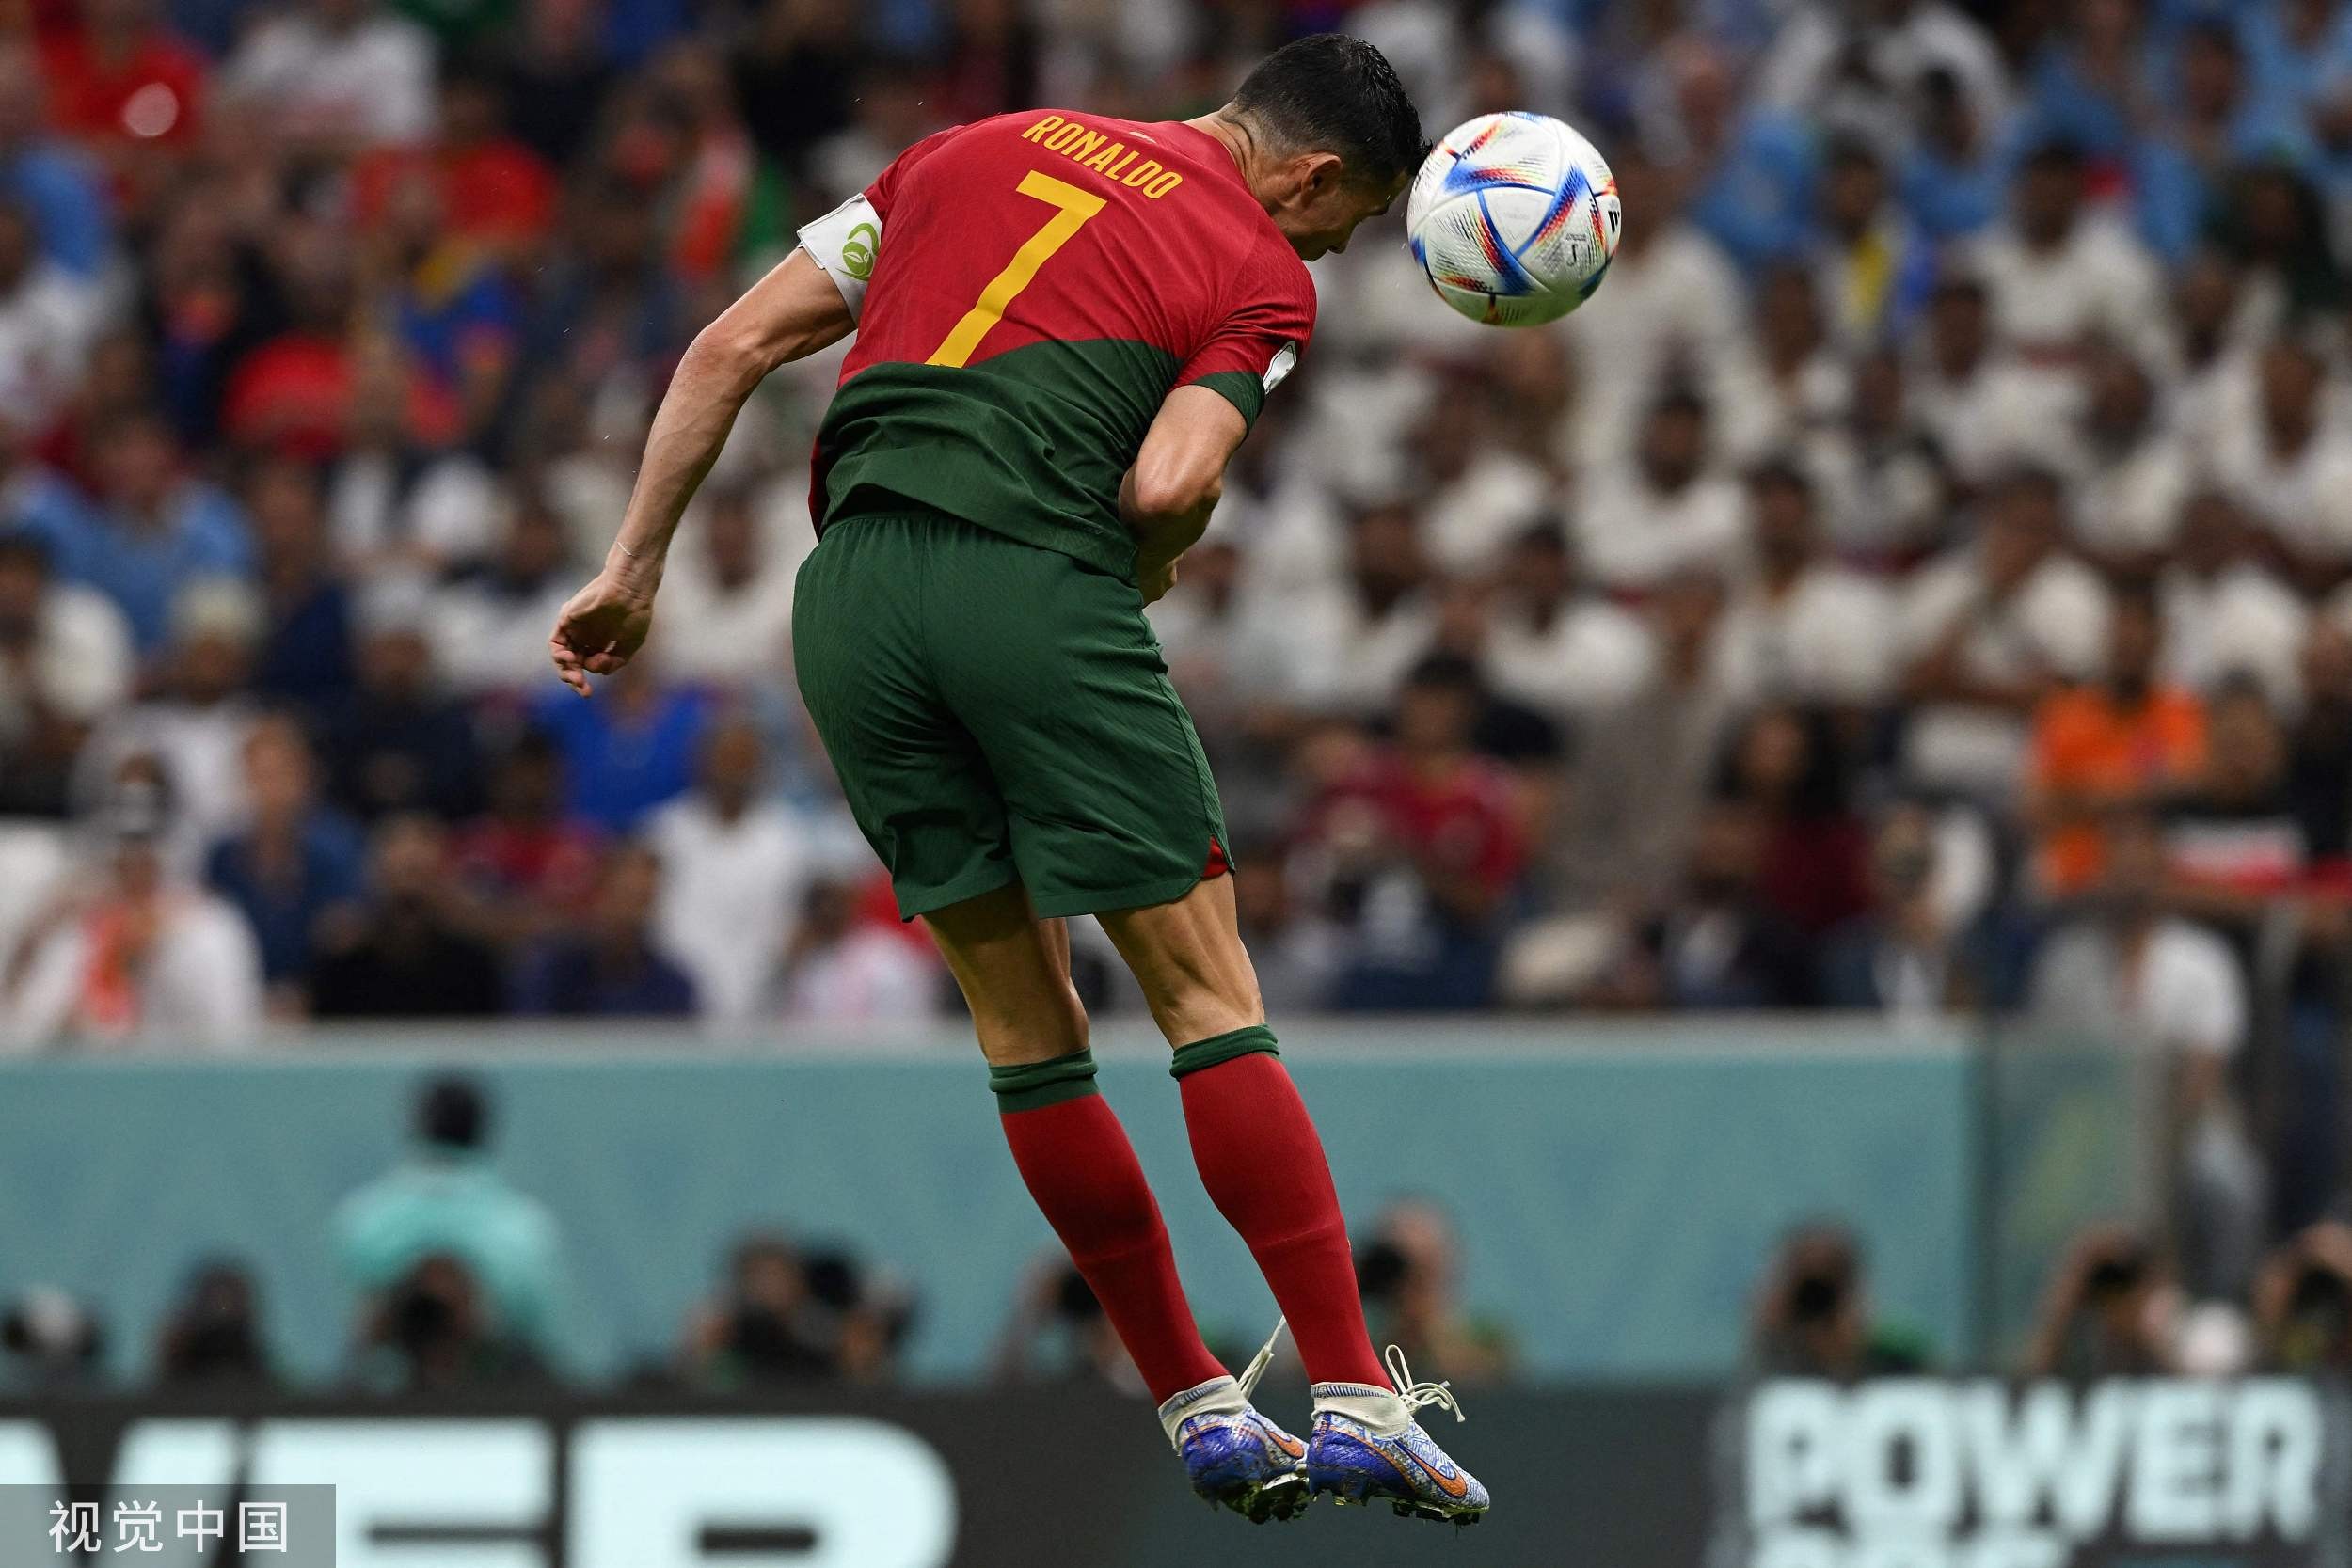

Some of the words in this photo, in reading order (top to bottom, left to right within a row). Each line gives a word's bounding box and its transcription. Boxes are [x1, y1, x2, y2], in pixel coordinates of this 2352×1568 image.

[1022, 115, 1184, 200] RONALDO
[925, 170, 1106, 368] 7
[1746, 1377, 2325, 1543] POWER
